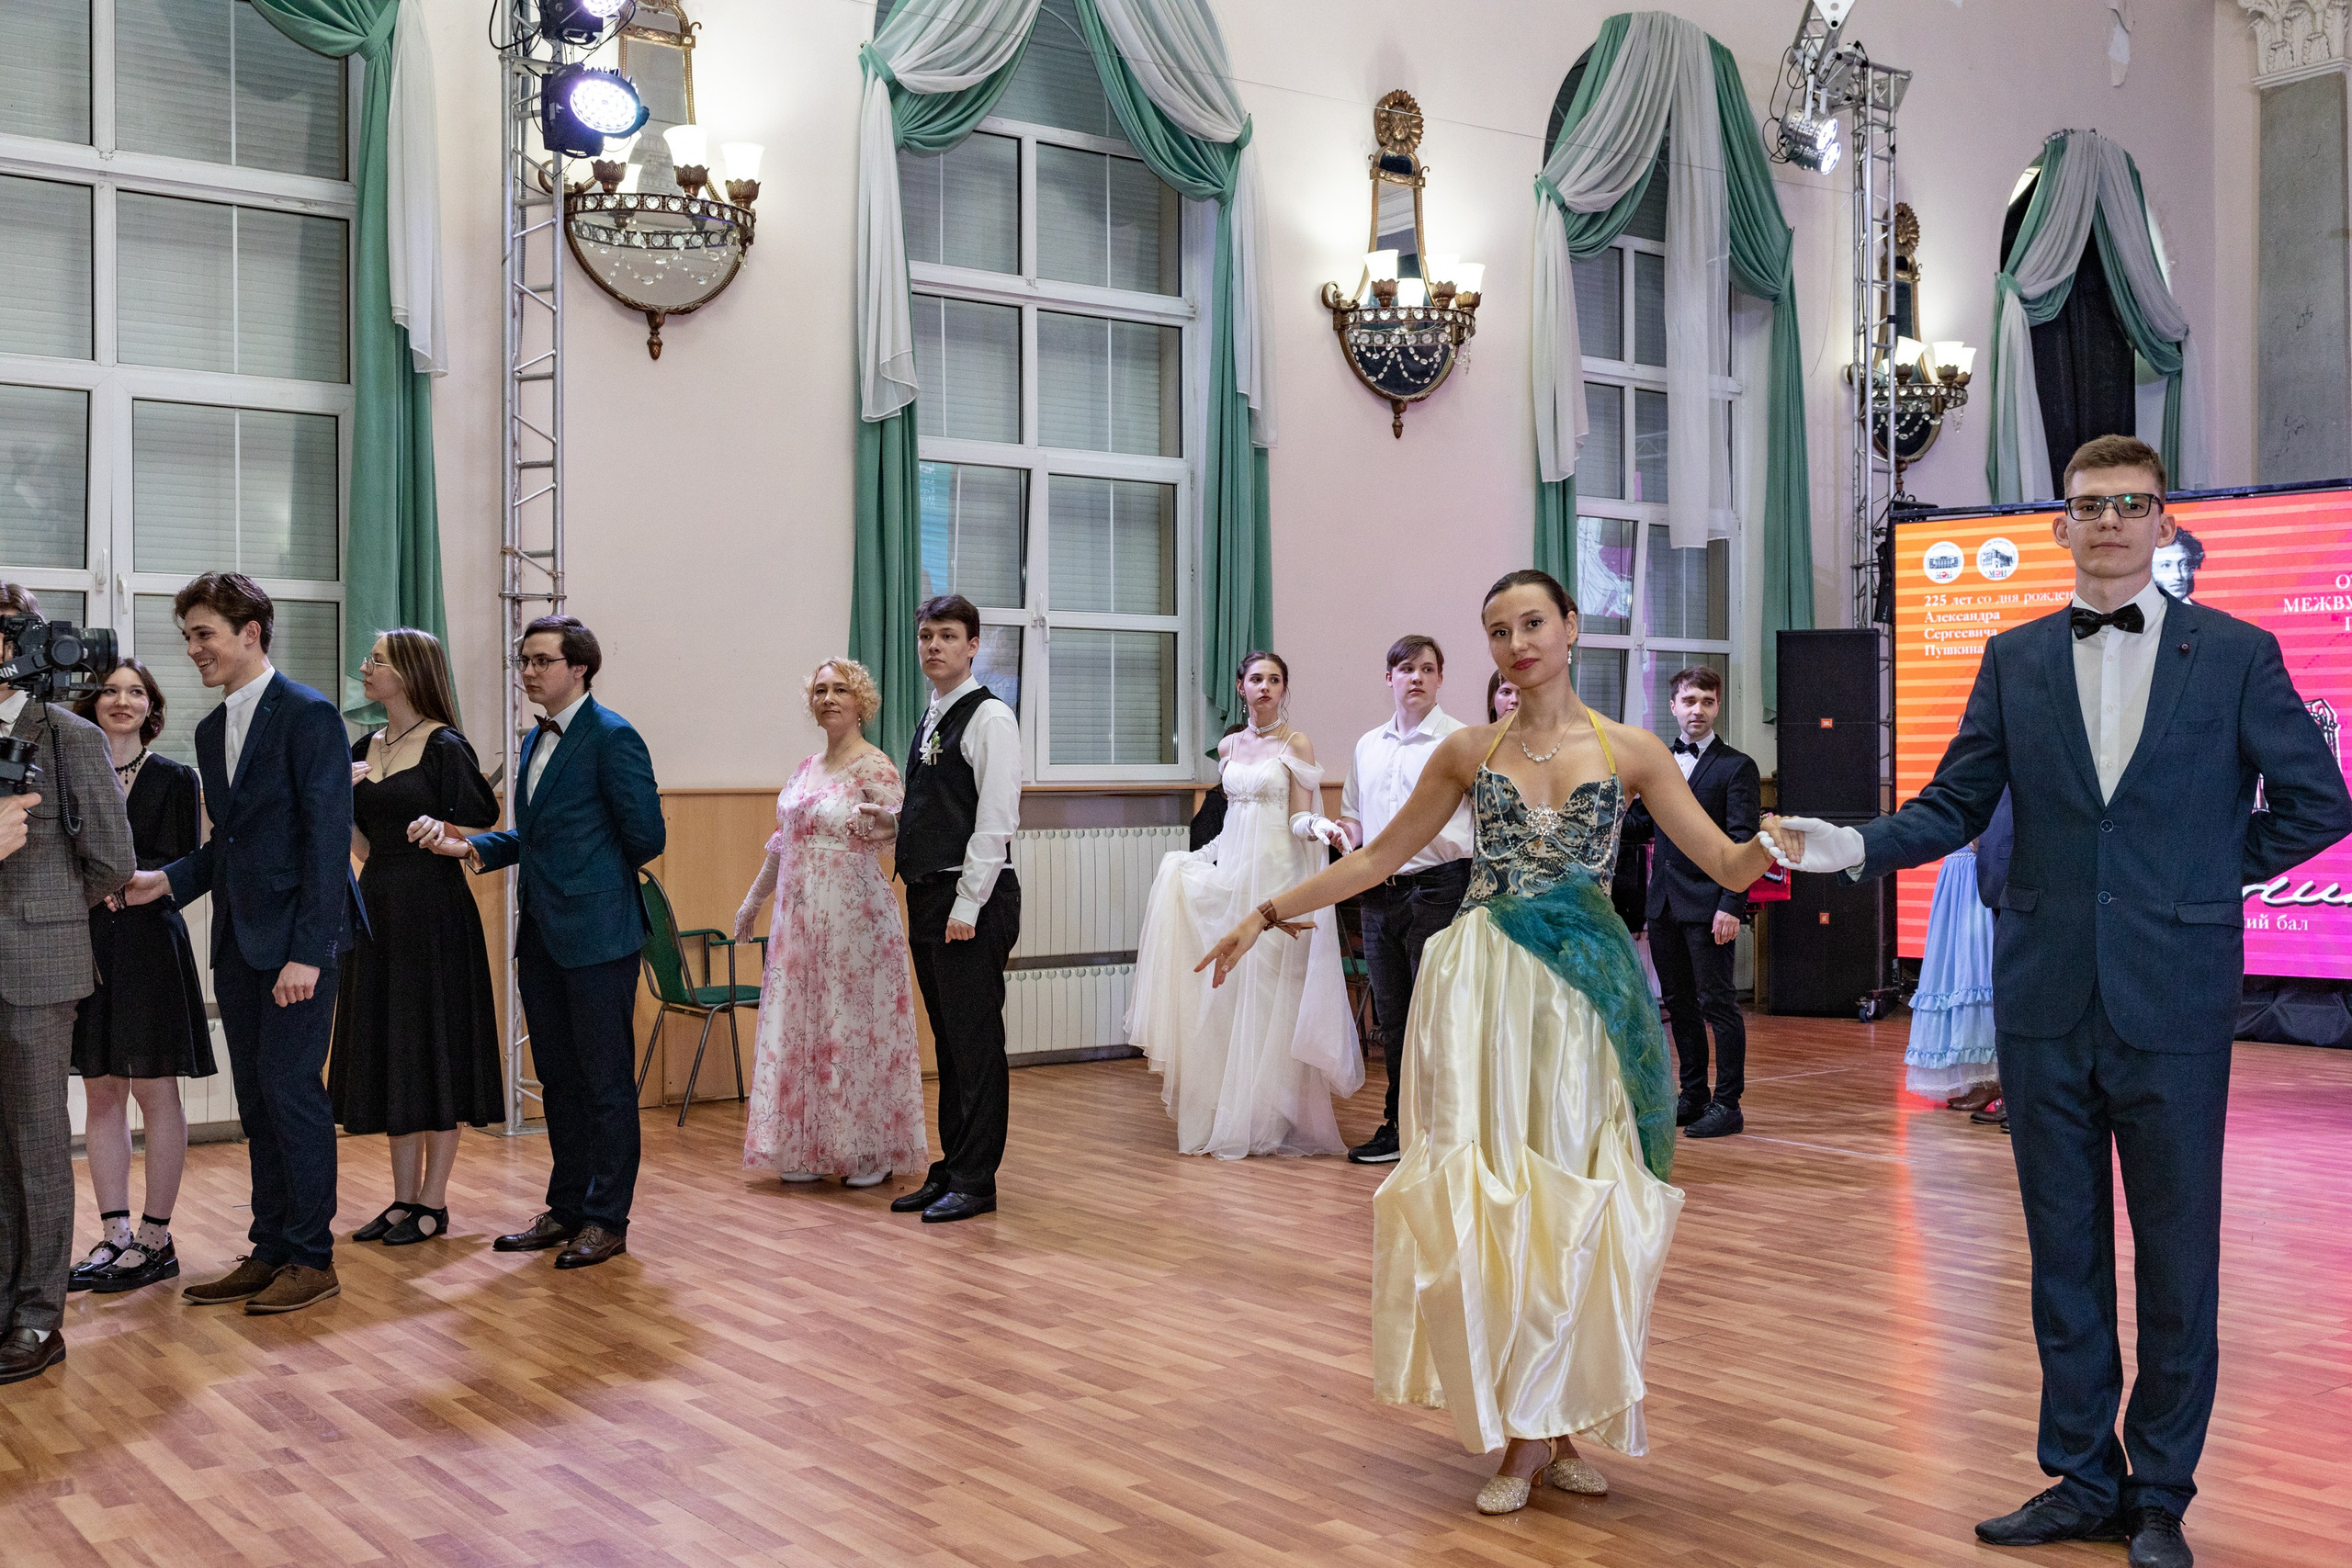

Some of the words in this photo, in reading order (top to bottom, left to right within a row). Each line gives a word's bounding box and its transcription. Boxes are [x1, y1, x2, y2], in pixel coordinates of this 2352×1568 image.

[1923, 594, 1947, 607] 225
[1951, 596, 1973, 606] лет
[1976, 595, 1992, 604] со
[1995, 594, 2019, 604] дня
[1924, 611, 2000, 624] Александра
[1924, 628, 1998, 641] Сергеевича
[1924, 644, 1984, 659] Пушкина
[2245, 913, 2269, 930] ий
[2277, 914, 2308, 931] бал
